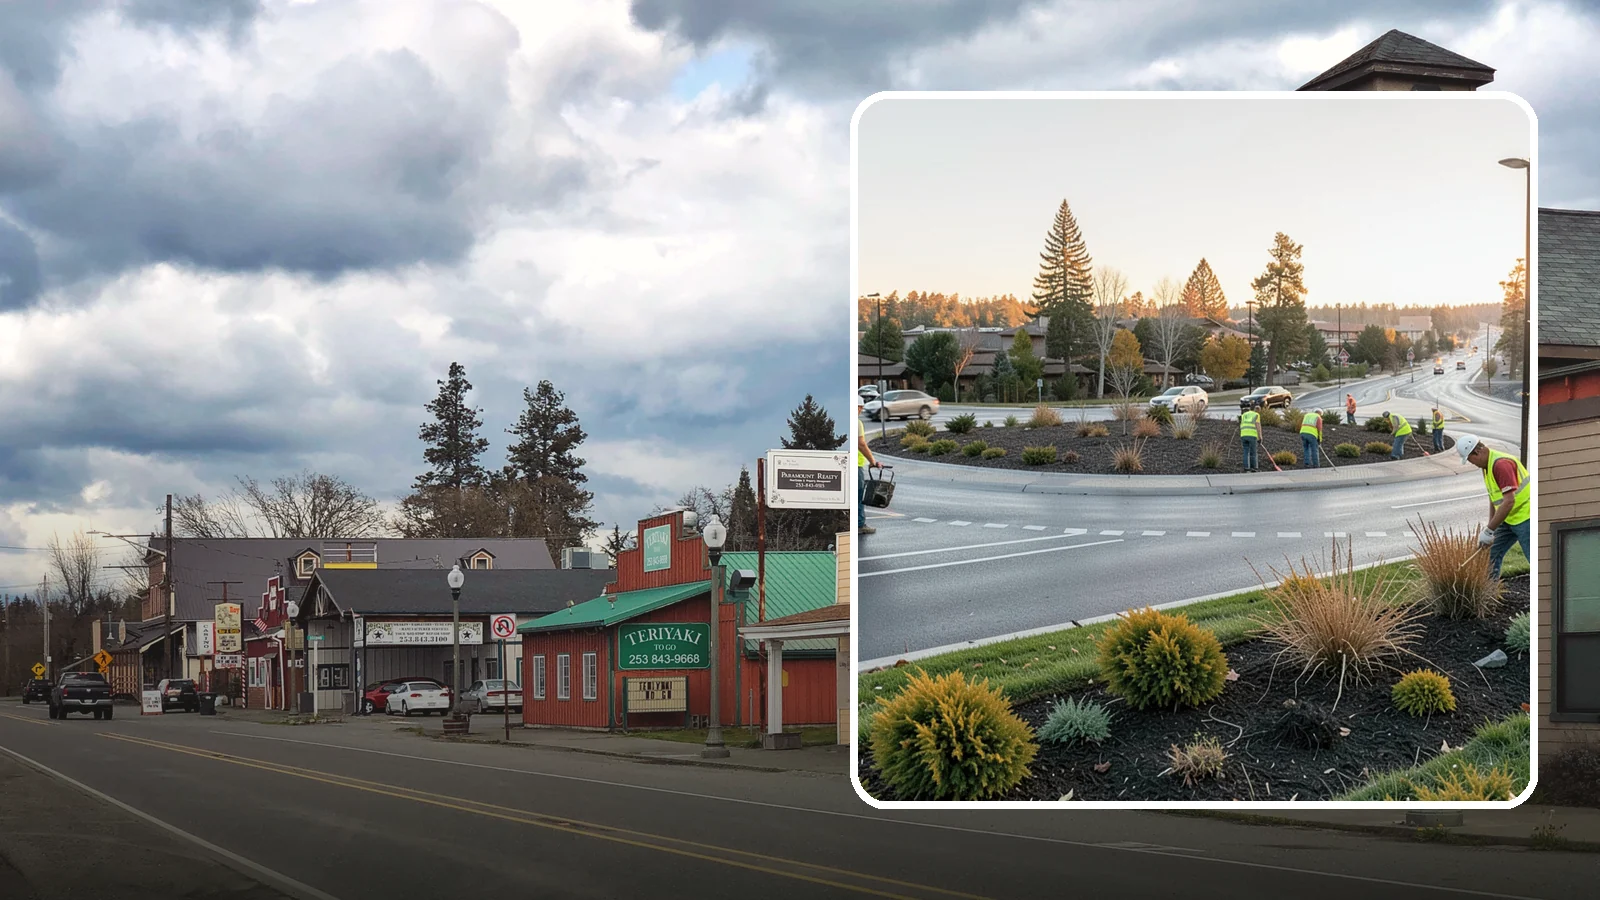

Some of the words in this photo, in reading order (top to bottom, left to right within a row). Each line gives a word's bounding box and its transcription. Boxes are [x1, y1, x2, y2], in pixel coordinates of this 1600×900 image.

[781, 471, 815, 479] PARAMOUNT
[817, 472, 839, 480] REALTY
[624, 627, 703, 646] TERIYAKI
[629, 654, 648, 665] 253
[651, 654, 700, 664] 843-9668
